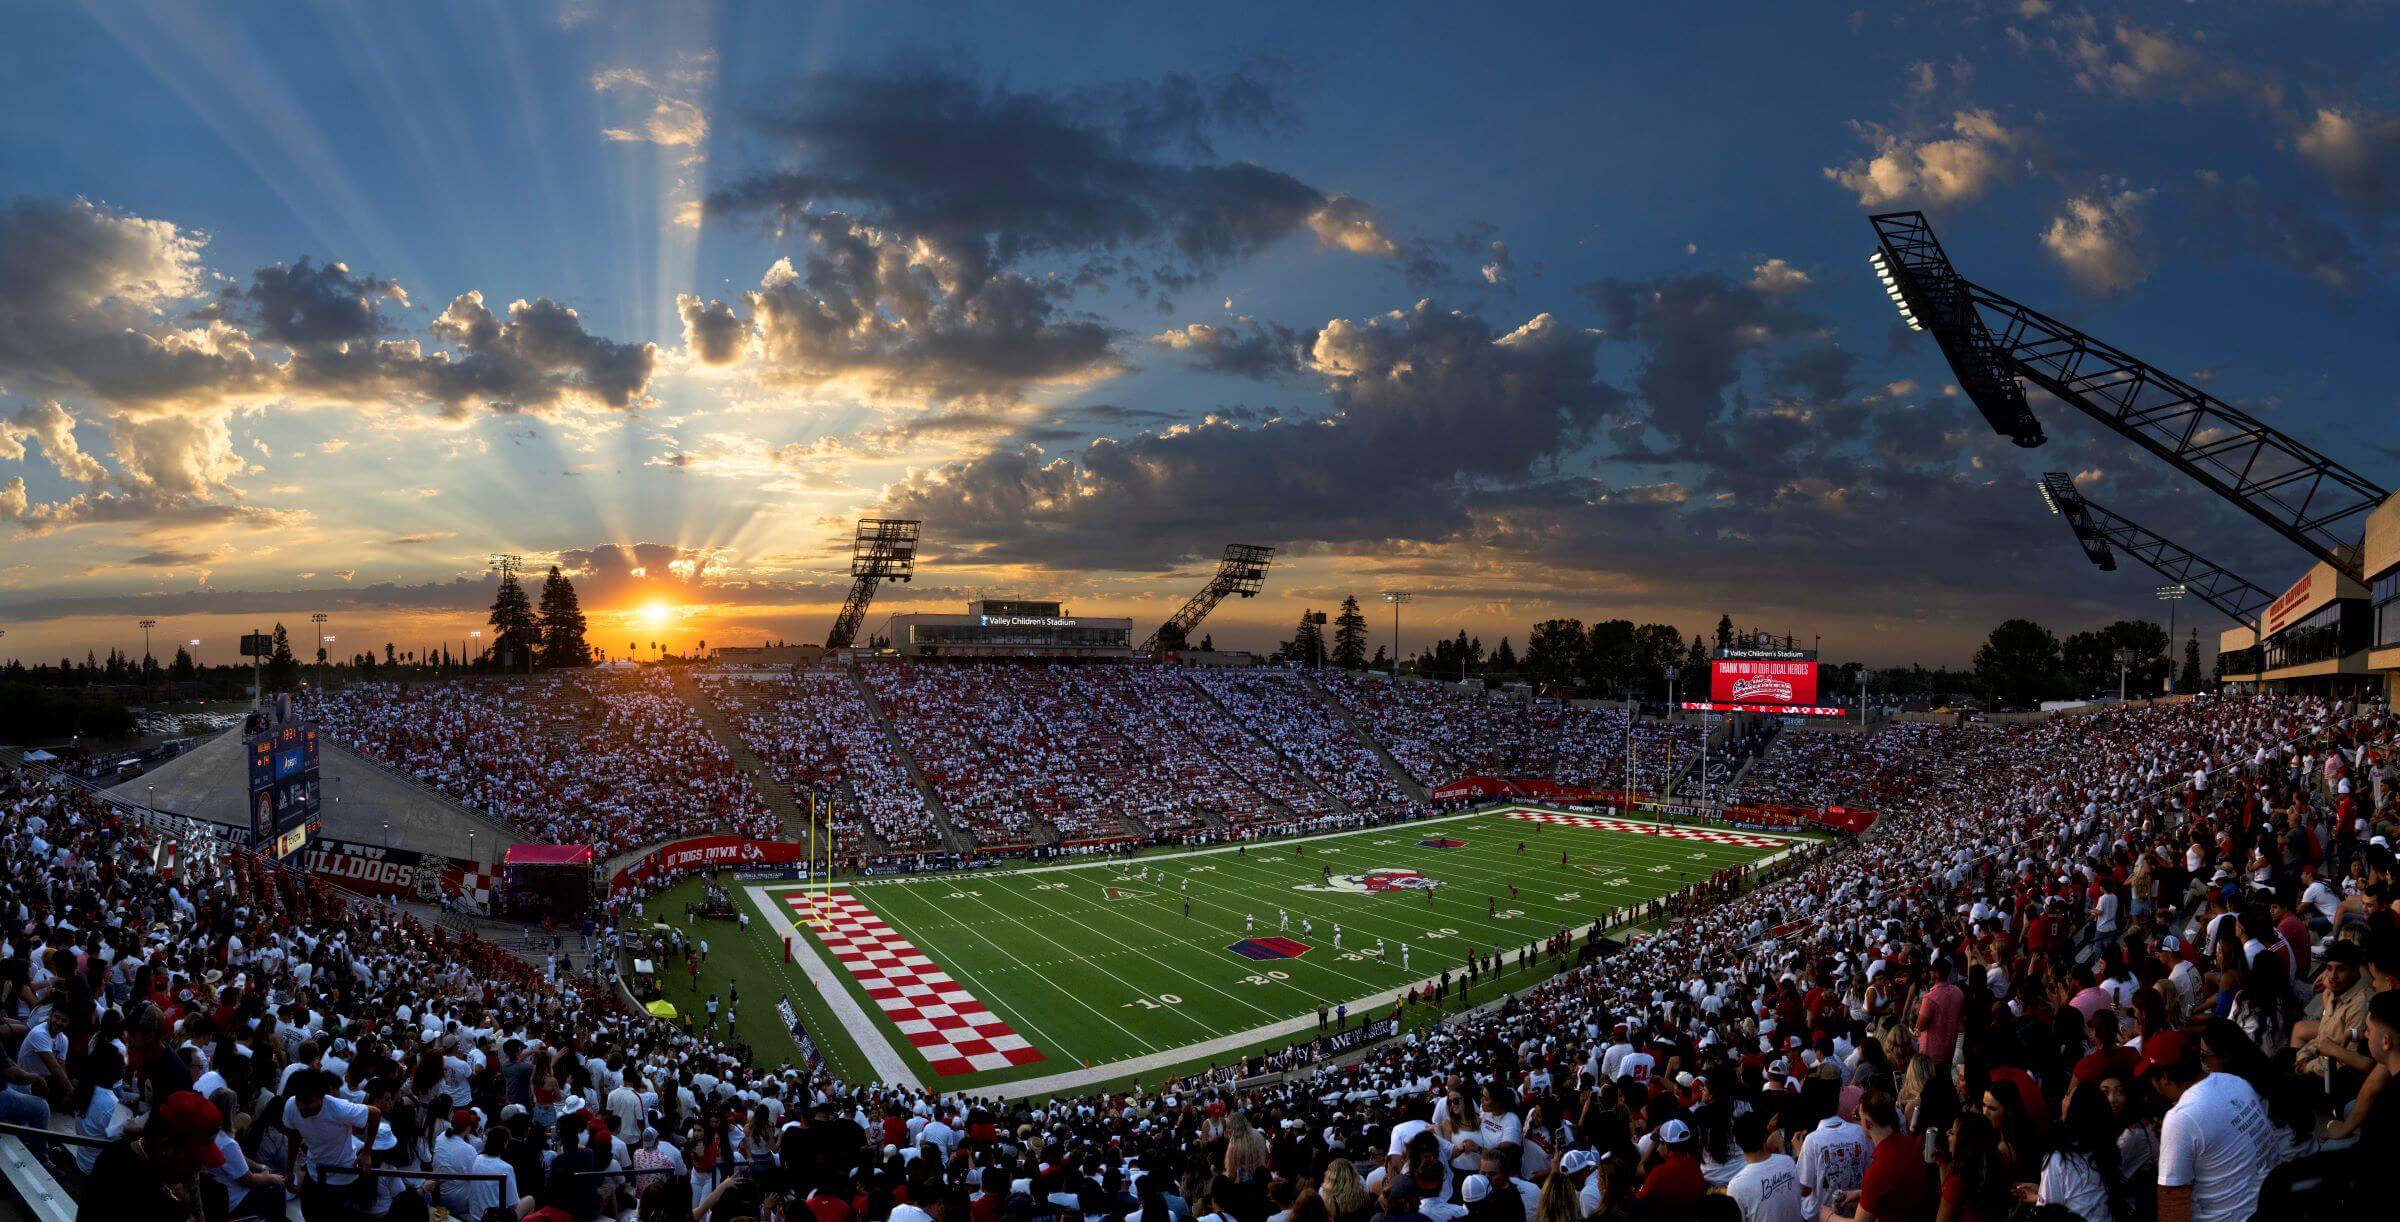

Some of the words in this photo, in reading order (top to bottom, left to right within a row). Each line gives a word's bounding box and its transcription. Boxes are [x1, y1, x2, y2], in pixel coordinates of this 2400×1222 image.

[989, 616, 1011, 626] Valley
[1011, 617, 1046, 625] Children's
[1046, 617, 1076, 626] Stadium
[1777, 650, 1804, 658] Stadium
[1719, 662, 1738, 674] THANK
[1738, 662, 1750, 674] YOU
[1751, 663, 1758, 674] TO
[1758, 663, 1770, 675] OUR
[1770, 663, 1787, 675] LOCAL
[1787, 663, 1809, 676] HEROES
[1245, 970, 1291, 985] 20
[1135, 994, 1184, 1010] 10
